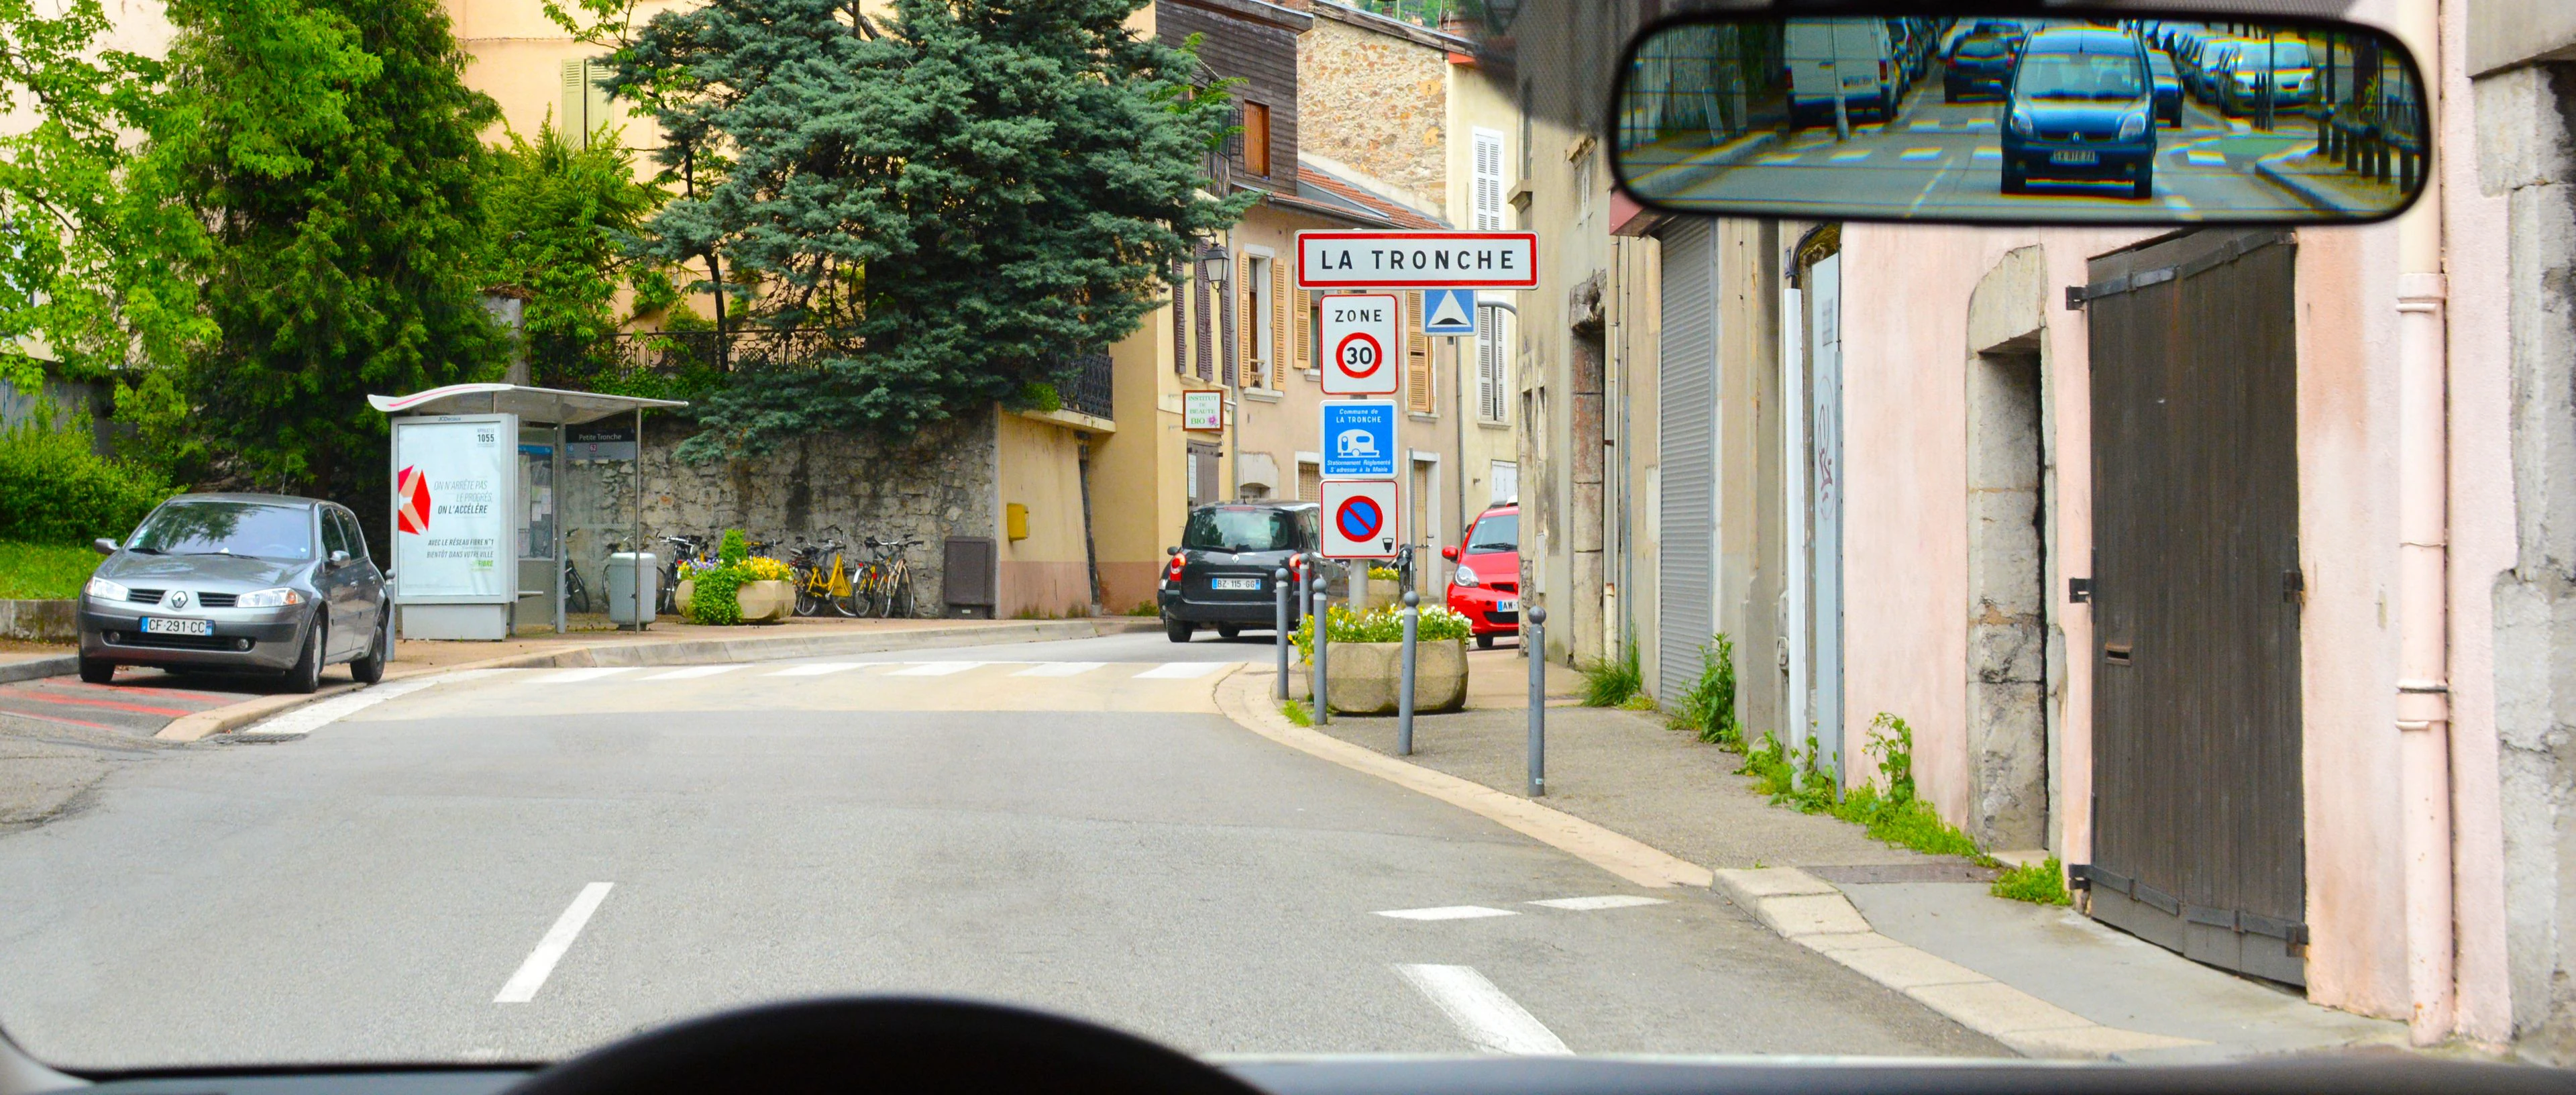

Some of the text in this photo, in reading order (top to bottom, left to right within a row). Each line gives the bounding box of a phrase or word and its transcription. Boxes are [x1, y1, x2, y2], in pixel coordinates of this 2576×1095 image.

[1322, 250, 1514, 270] LA TRONCHE
[1335, 309, 1382, 323] ZONE
[1346, 346, 1373, 365] 30
[477, 433, 494, 443] 1055
[434, 481, 443, 490] ON
[476, 480, 488, 490] PAS
[456, 493, 463, 503] LE
[438, 505, 447, 515] ON
